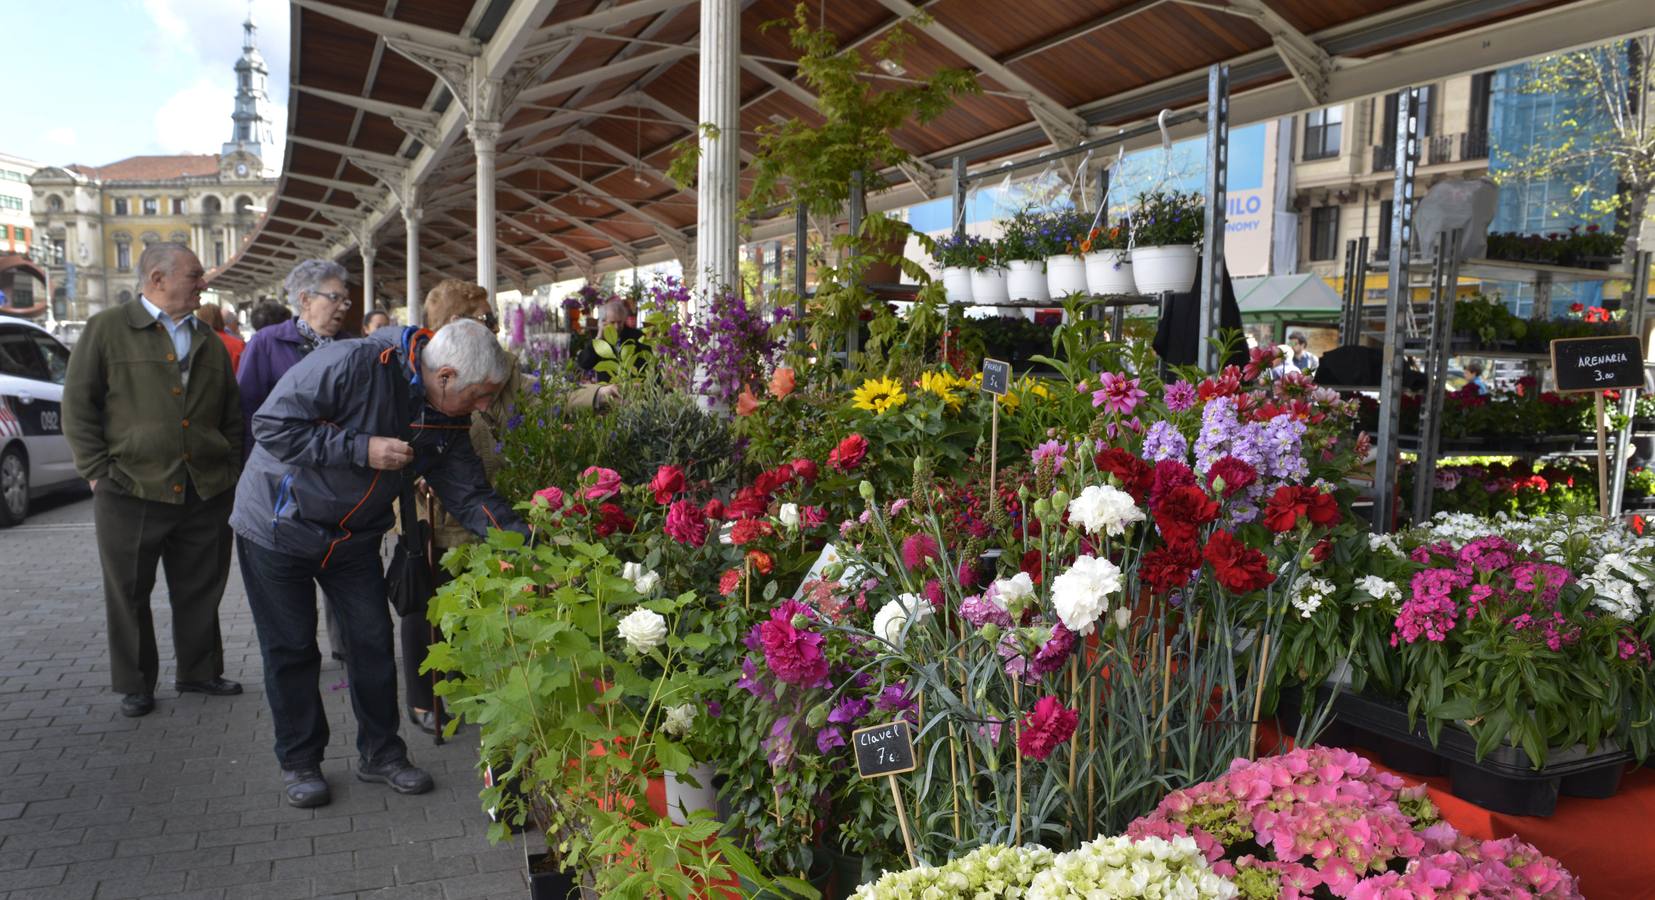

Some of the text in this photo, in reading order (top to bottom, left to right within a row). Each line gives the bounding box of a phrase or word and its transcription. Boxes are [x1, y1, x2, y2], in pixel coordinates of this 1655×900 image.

[1227, 194, 1262, 215] ILO
[1226, 220, 1260, 232] NOMY
[860, 724, 900, 746] Clavel
